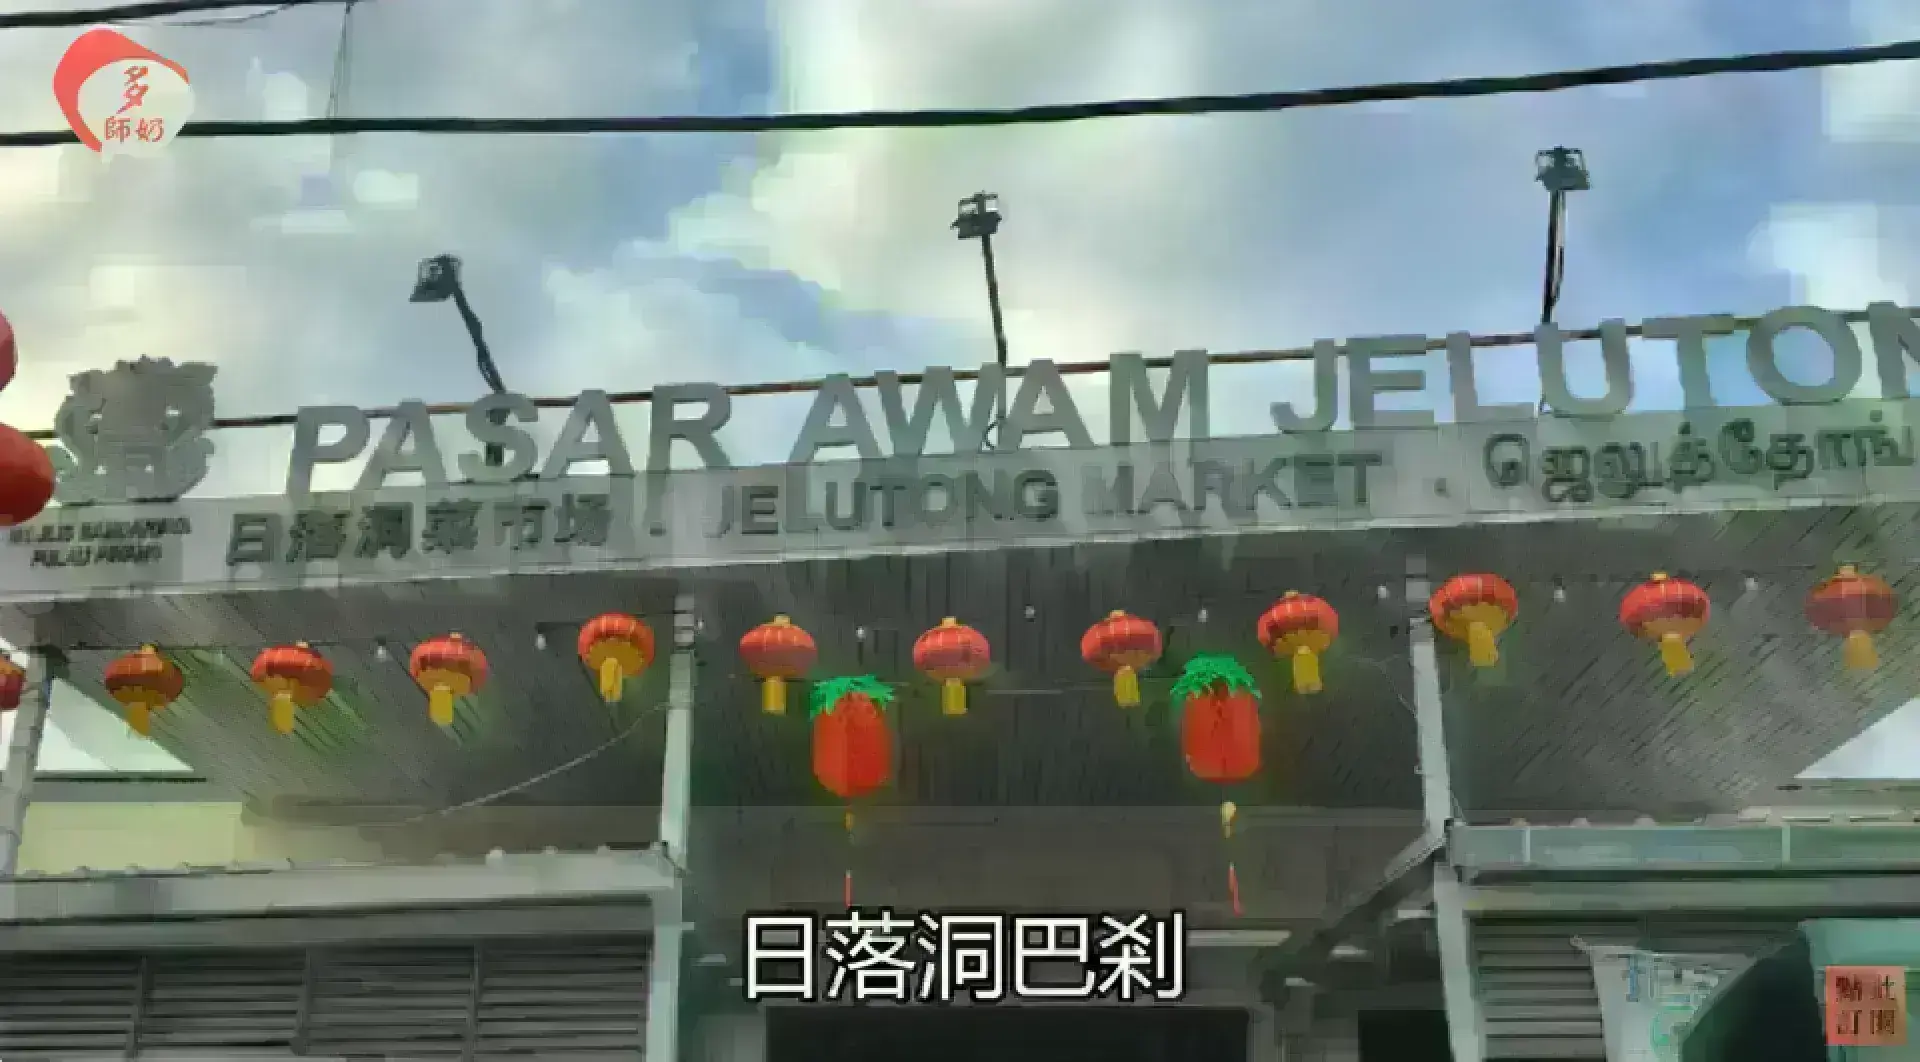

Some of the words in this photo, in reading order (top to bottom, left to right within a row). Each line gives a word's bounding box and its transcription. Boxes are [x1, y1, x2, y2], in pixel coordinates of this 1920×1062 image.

[287, 381, 734, 494] PASAR
[788, 348, 1210, 464] AWAM
[702, 468, 1060, 539] JELUTONG
[1080, 453, 1383, 515] MARKET
